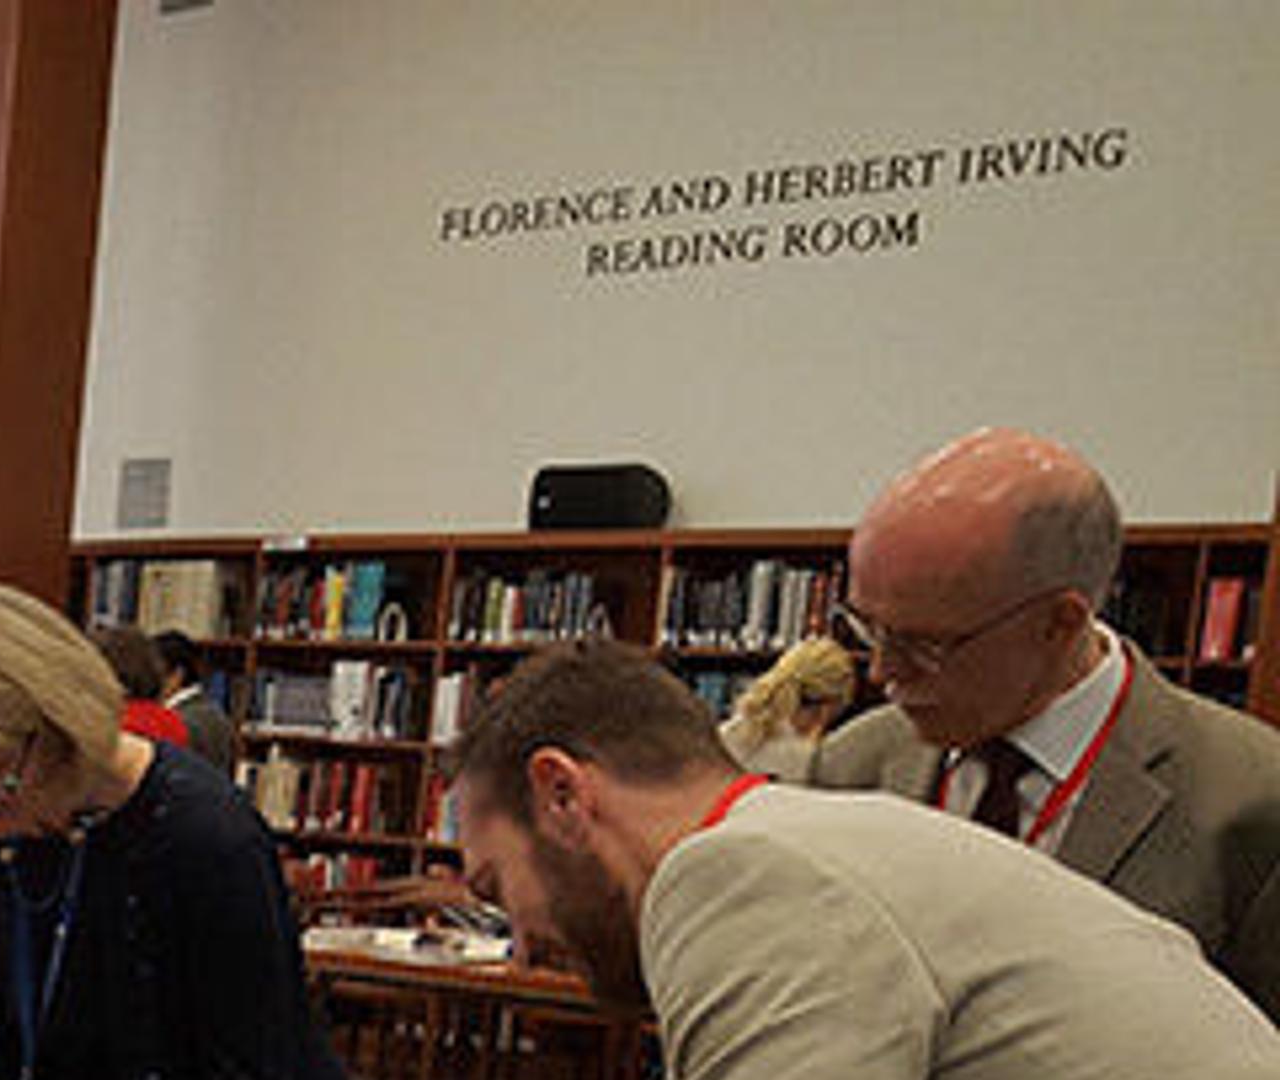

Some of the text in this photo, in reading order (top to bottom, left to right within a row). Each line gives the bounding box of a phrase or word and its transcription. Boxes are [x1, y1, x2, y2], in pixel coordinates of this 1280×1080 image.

[441, 129, 1129, 240] FLORENCE AND HERBERT IRVING
[586, 211, 921, 276] READING ROOM
